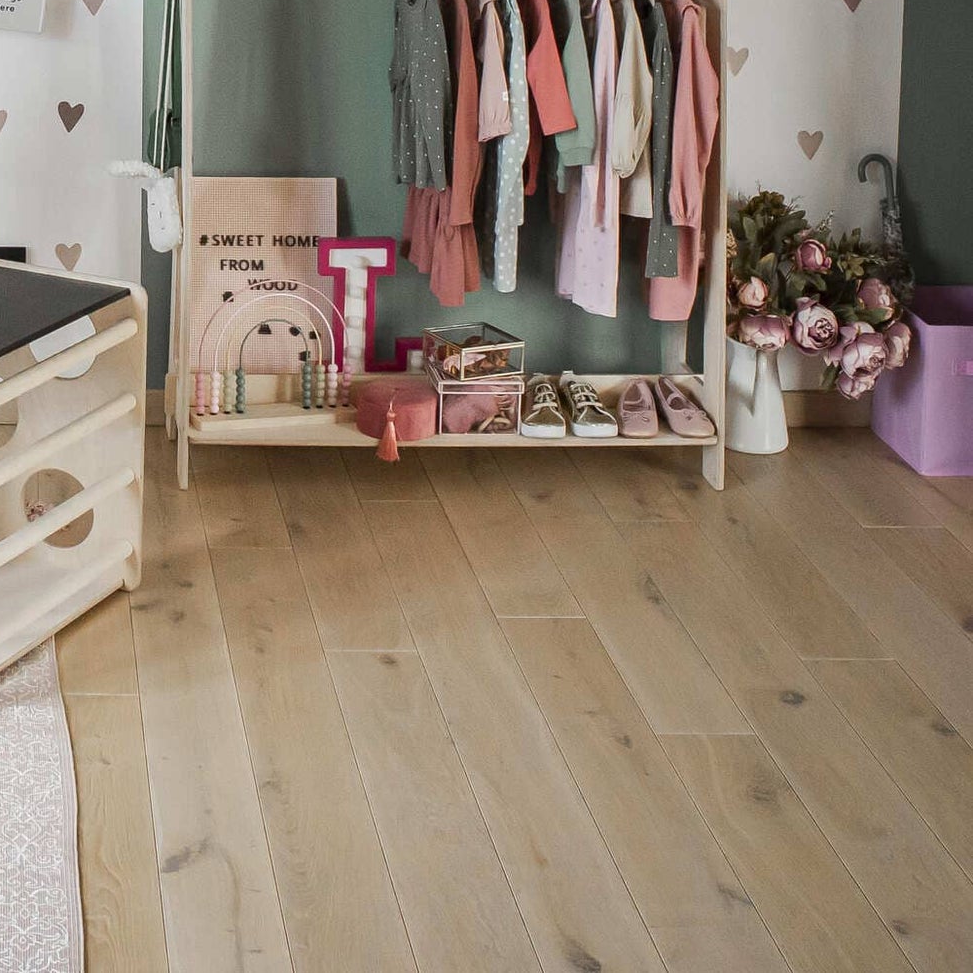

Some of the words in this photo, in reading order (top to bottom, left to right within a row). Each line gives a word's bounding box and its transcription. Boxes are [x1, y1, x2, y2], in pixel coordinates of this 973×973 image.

[198, 234, 265, 247] #SWEET
[273, 235, 320, 247] HOME
[220, 259, 264, 271] FROM
[248, 278, 298, 291] WOOD
